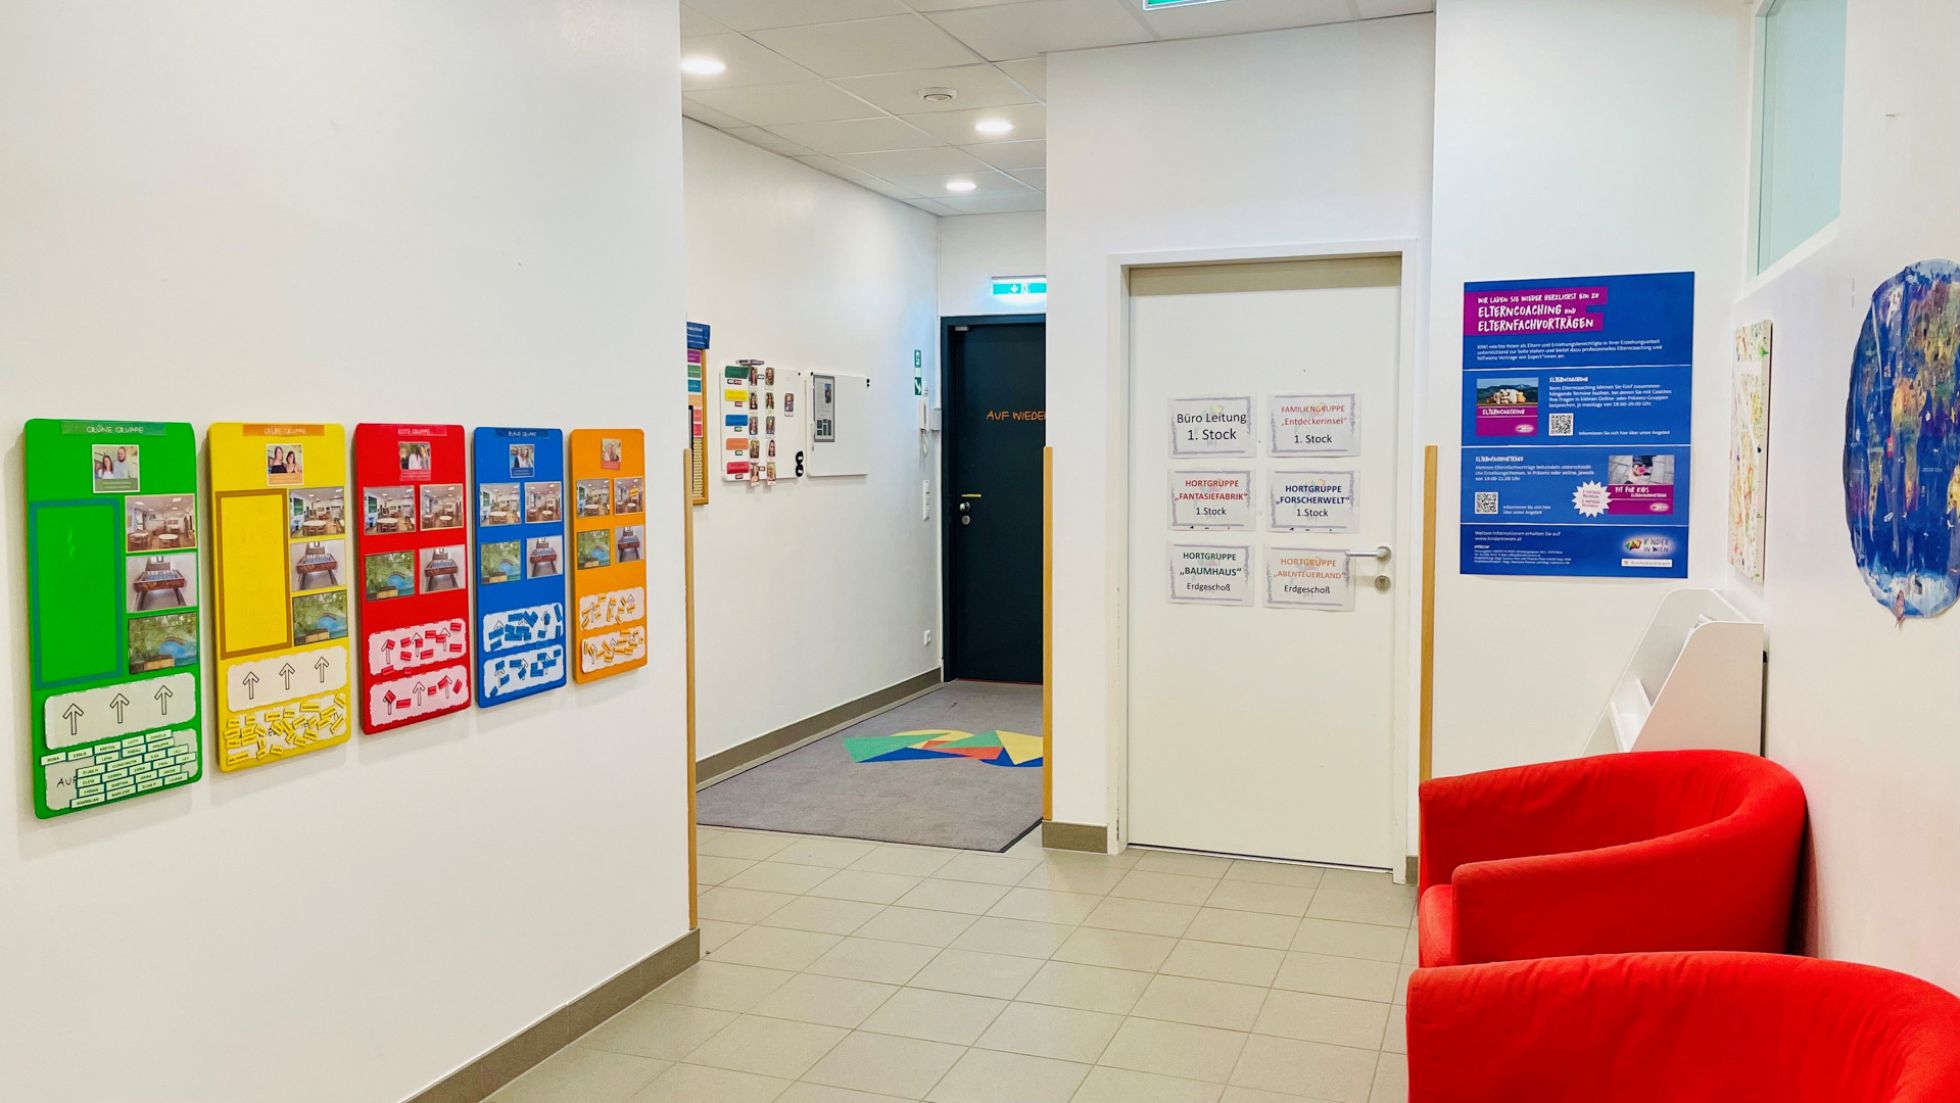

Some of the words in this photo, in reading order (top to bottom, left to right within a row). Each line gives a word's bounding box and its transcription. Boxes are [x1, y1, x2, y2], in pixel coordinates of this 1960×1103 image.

[1510, 295, 1519, 303] SIE
[1478, 304, 1562, 318] ELTERNCOACHING
[1478, 316, 1594, 332] ELTERNFACHVORTRÄGEN
[1281, 405, 1345, 413] FAMILIENGRUPPE
[986, 410, 1010, 421] AUF
[1177, 413, 1203, 423] Büro
[1206, 413, 1247, 424] Leitung
[86, 425, 112, 434] GRÜNE
[115, 426, 144, 434] GRUPPE
[1188, 429, 1198, 440] 1.
[1202, 428, 1237, 440] Stock
[1294, 435, 1303, 444] 1.
[1305, 434, 1332, 444] Stock
[1285, 485, 1342, 493] HORTGRUPPE
[1183, 552, 1237, 561] HORTGRUPPE
[1280, 558, 1337, 567] HORTGRUPPE
[1186, 582, 1231, 592] Erdgeschoß
[1284, 584, 1331, 594] Erdgeschoß
